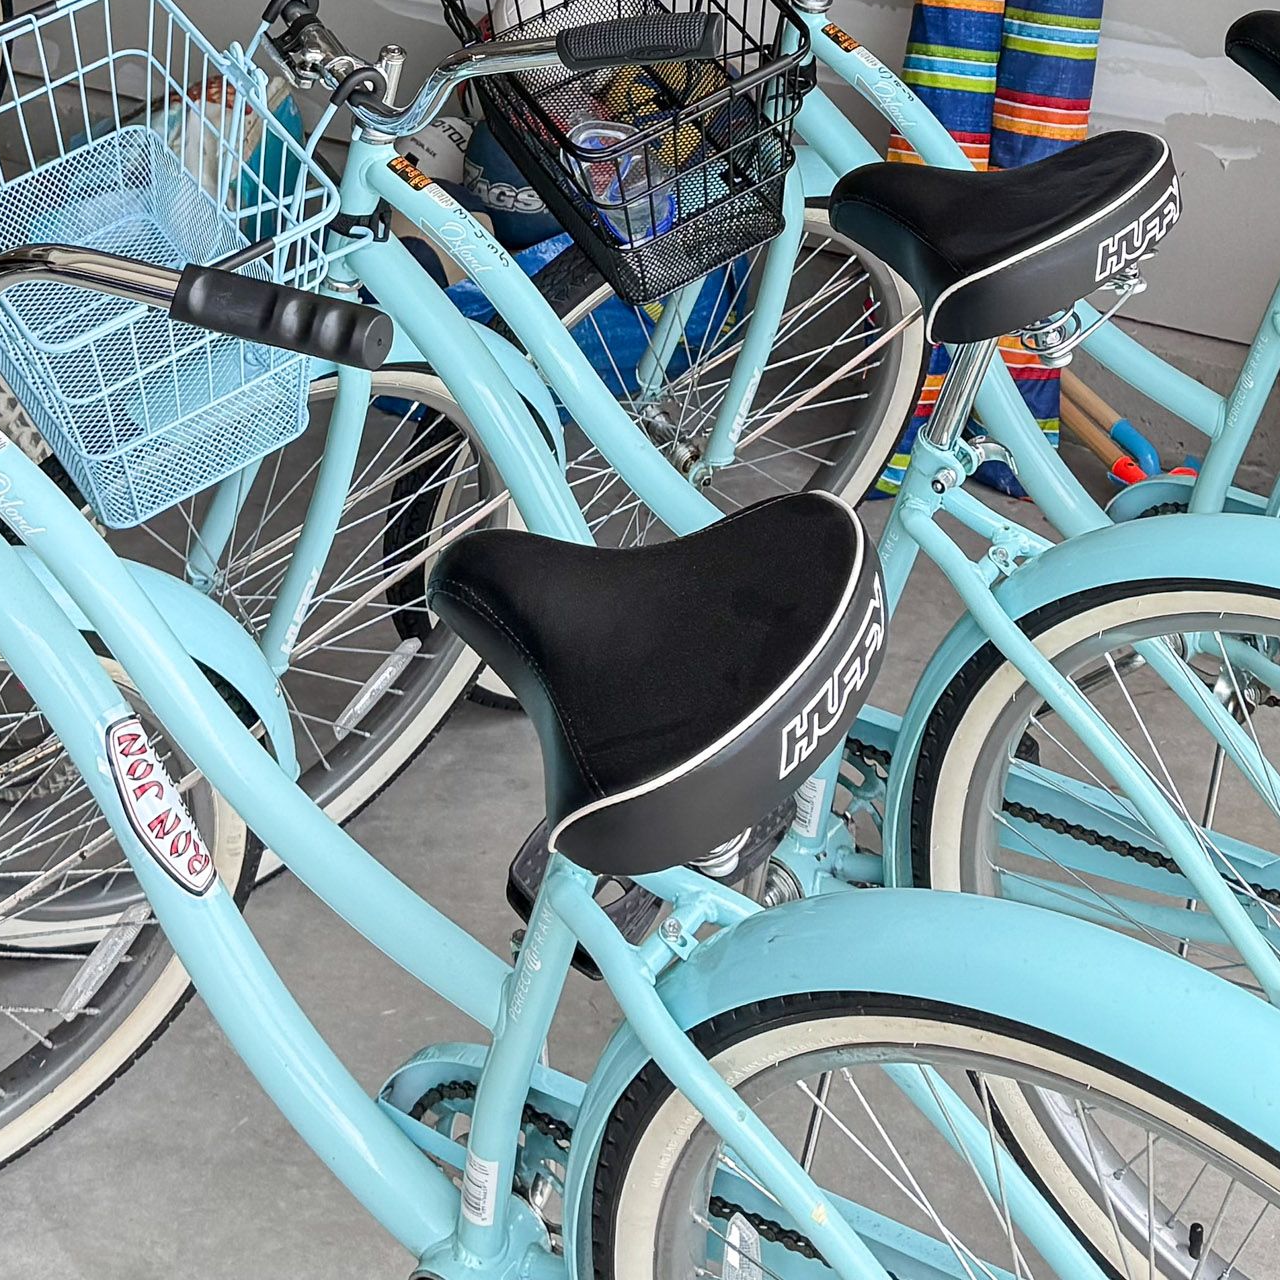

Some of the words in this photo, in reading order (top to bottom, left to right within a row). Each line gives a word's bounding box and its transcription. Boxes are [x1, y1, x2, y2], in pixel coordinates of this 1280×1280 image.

[439, 221, 493, 273] Oxford
[1095, 174, 1180, 282] HUFFY
[778, 571, 885, 776] HUFFY
[117, 732, 165, 802] JON
[147, 806, 211, 876] RON
[508, 965, 533, 1021] PERFECT
